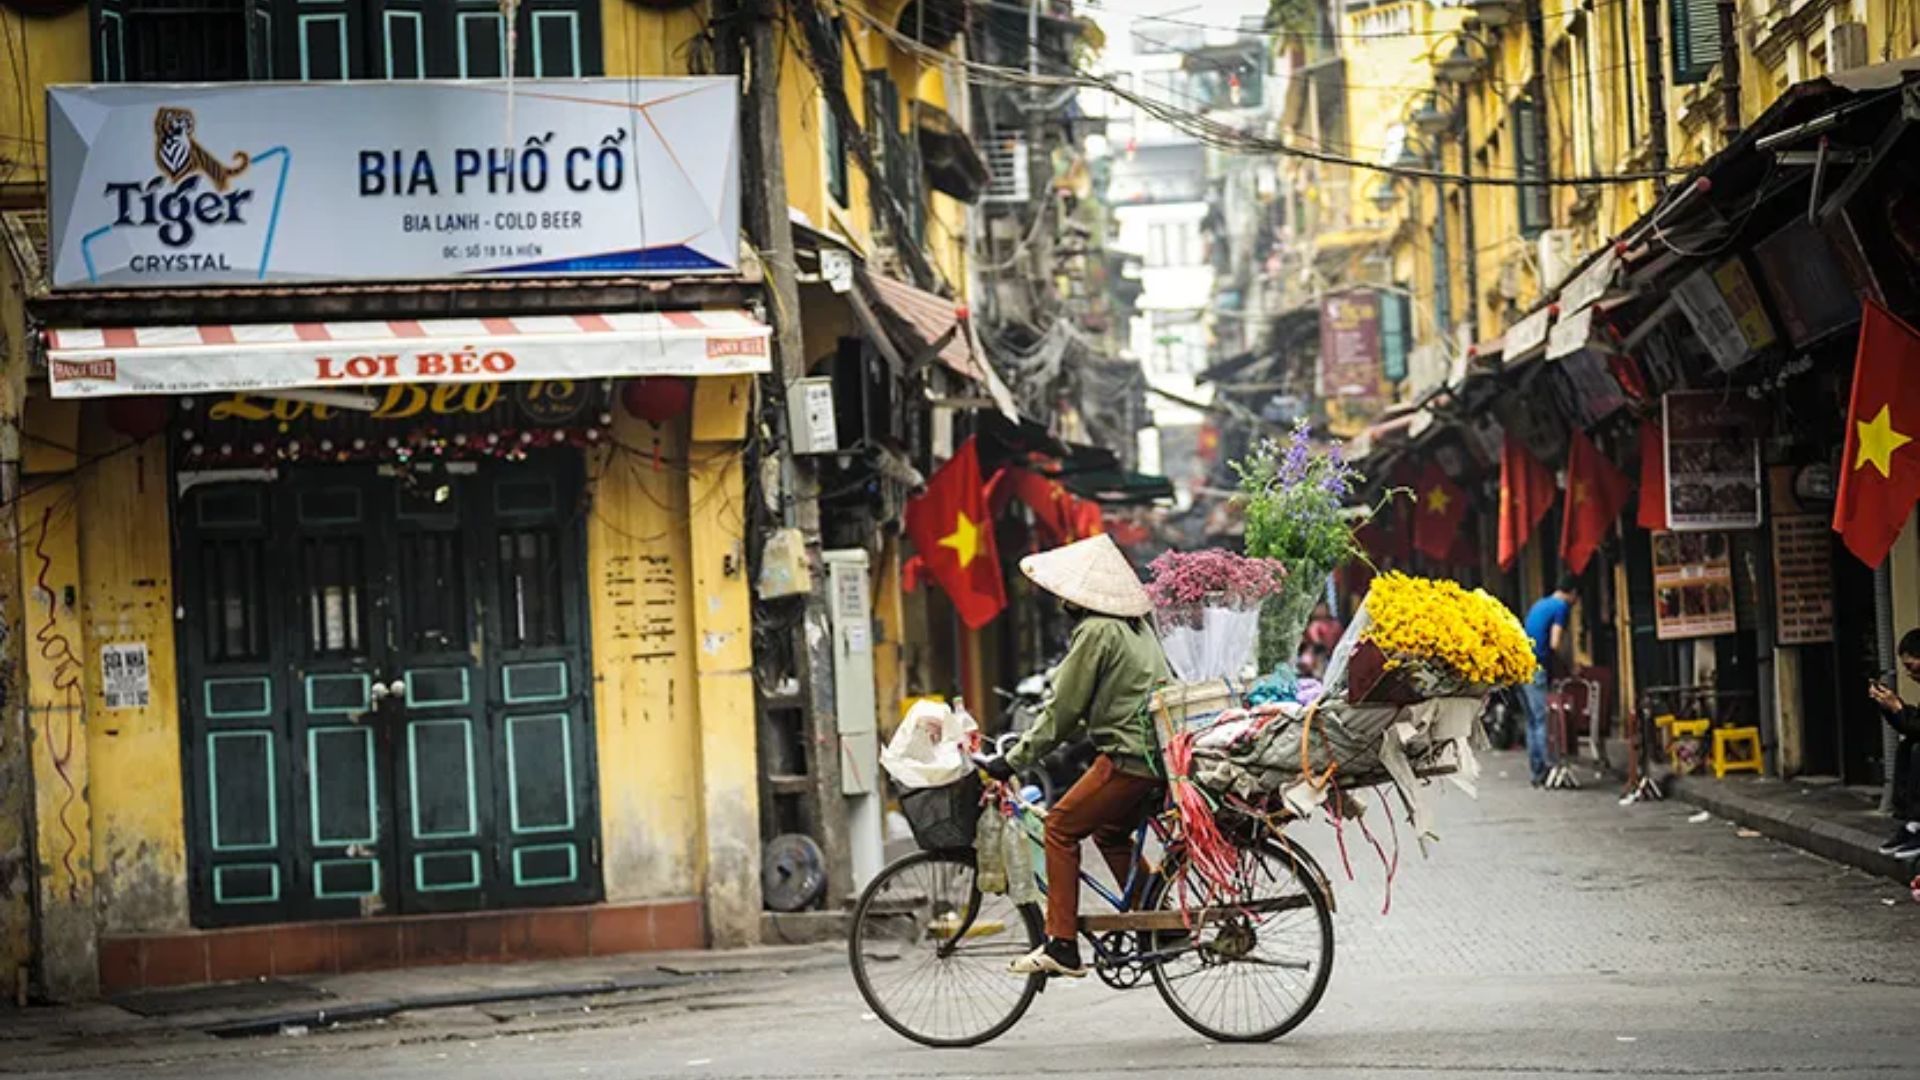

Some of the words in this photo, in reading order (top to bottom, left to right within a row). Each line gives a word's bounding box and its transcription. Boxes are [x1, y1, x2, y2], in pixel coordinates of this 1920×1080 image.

[358, 149, 438, 196] BIA
[454, 132, 555, 195] PHỐ
[565, 128, 626, 192] CỔ
[403, 214, 431, 232] BIA
[435, 213, 480, 235] LẠNH
[494, 211, 537, 231] COLD
[541, 210, 582, 230] BEER
[129, 252, 231, 272] CRYSTAL
[416, 345, 516, 375] BÉO
